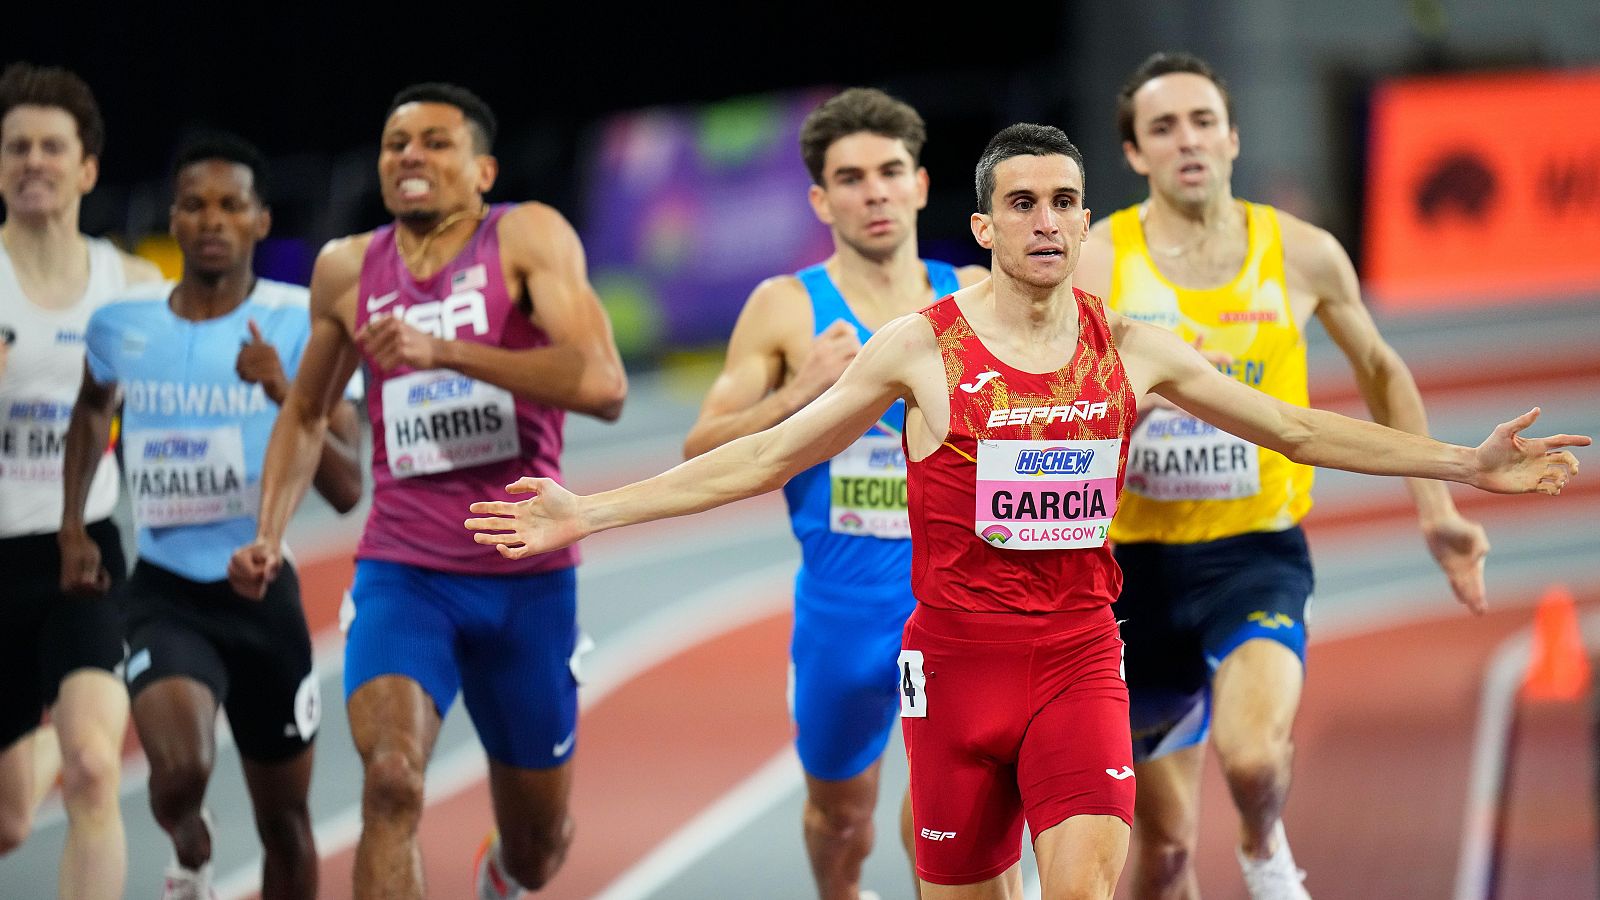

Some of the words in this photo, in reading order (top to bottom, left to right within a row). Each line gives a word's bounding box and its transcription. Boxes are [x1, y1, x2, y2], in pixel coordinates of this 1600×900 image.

[128, 380, 268, 416] OTSWANA
[986, 400, 1108, 428] ESPAÑA
[396, 403, 502, 446] HARRIS
[1014, 448, 1095, 475] HI-CHEW
[991, 483, 1107, 520] GARCÍA
[1018, 526, 1096, 542] GLASGOW
[902, 661, 916, 708] 4
[920, 827, 957, 842] ESP
